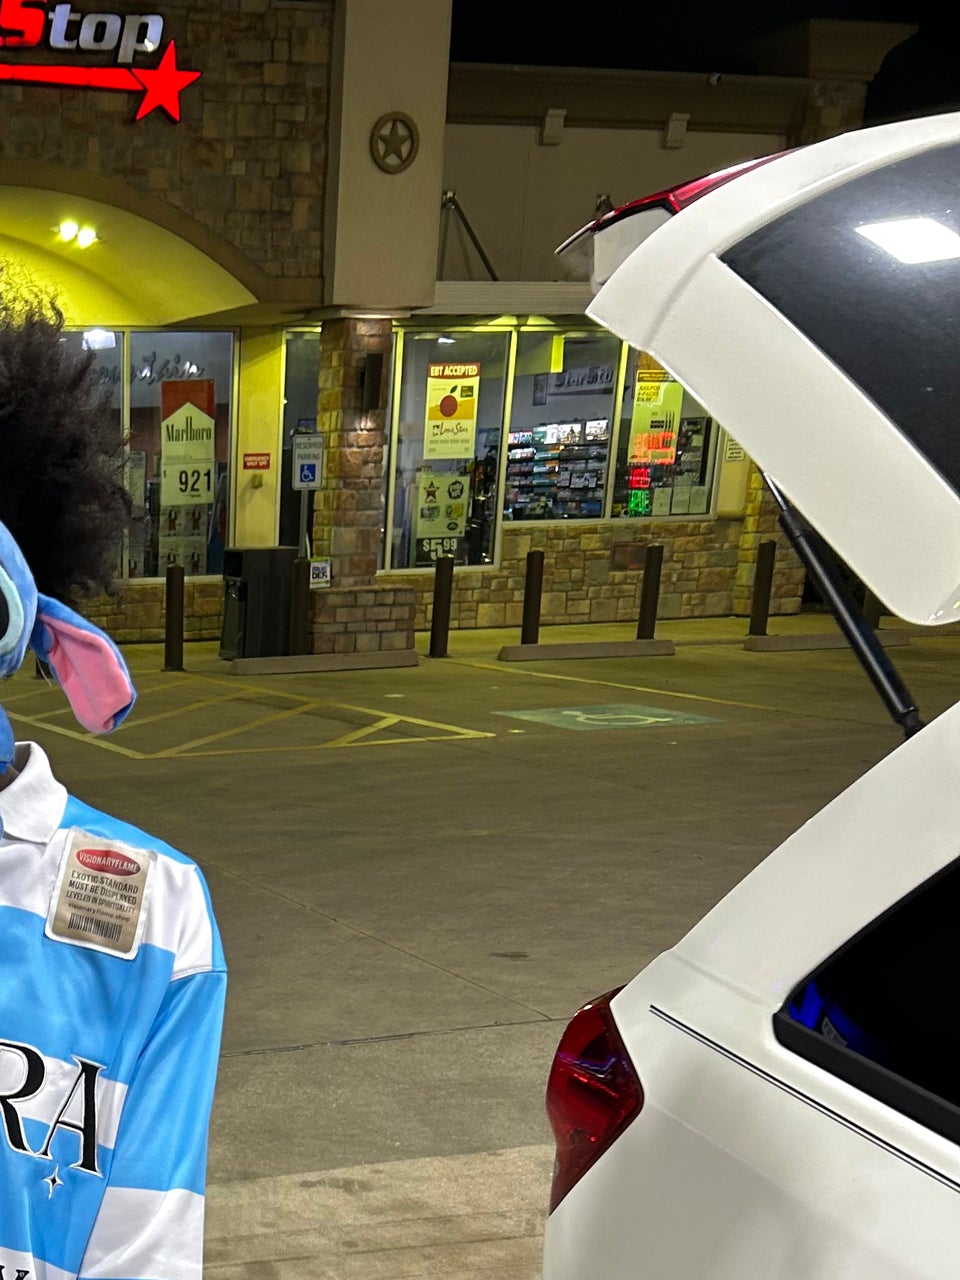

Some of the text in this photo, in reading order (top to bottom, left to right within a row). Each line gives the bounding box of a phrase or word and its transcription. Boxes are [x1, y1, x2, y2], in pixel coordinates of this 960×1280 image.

[430, 366, 478, 377] EBT ACCEPTED
[586, 365, 615, 385] Sto
[166, 417, 212, 442] Marlboro
[80, 851, 138, 873] VISIONARYFLAME
[68, 880, 137, 905] MUST BE DISPLAYED
[71, 870, 138, 894] EXOTIC STANDARD
[66, 890, 91, 902] LEVELED
[91, 896, 98, 904] IN
